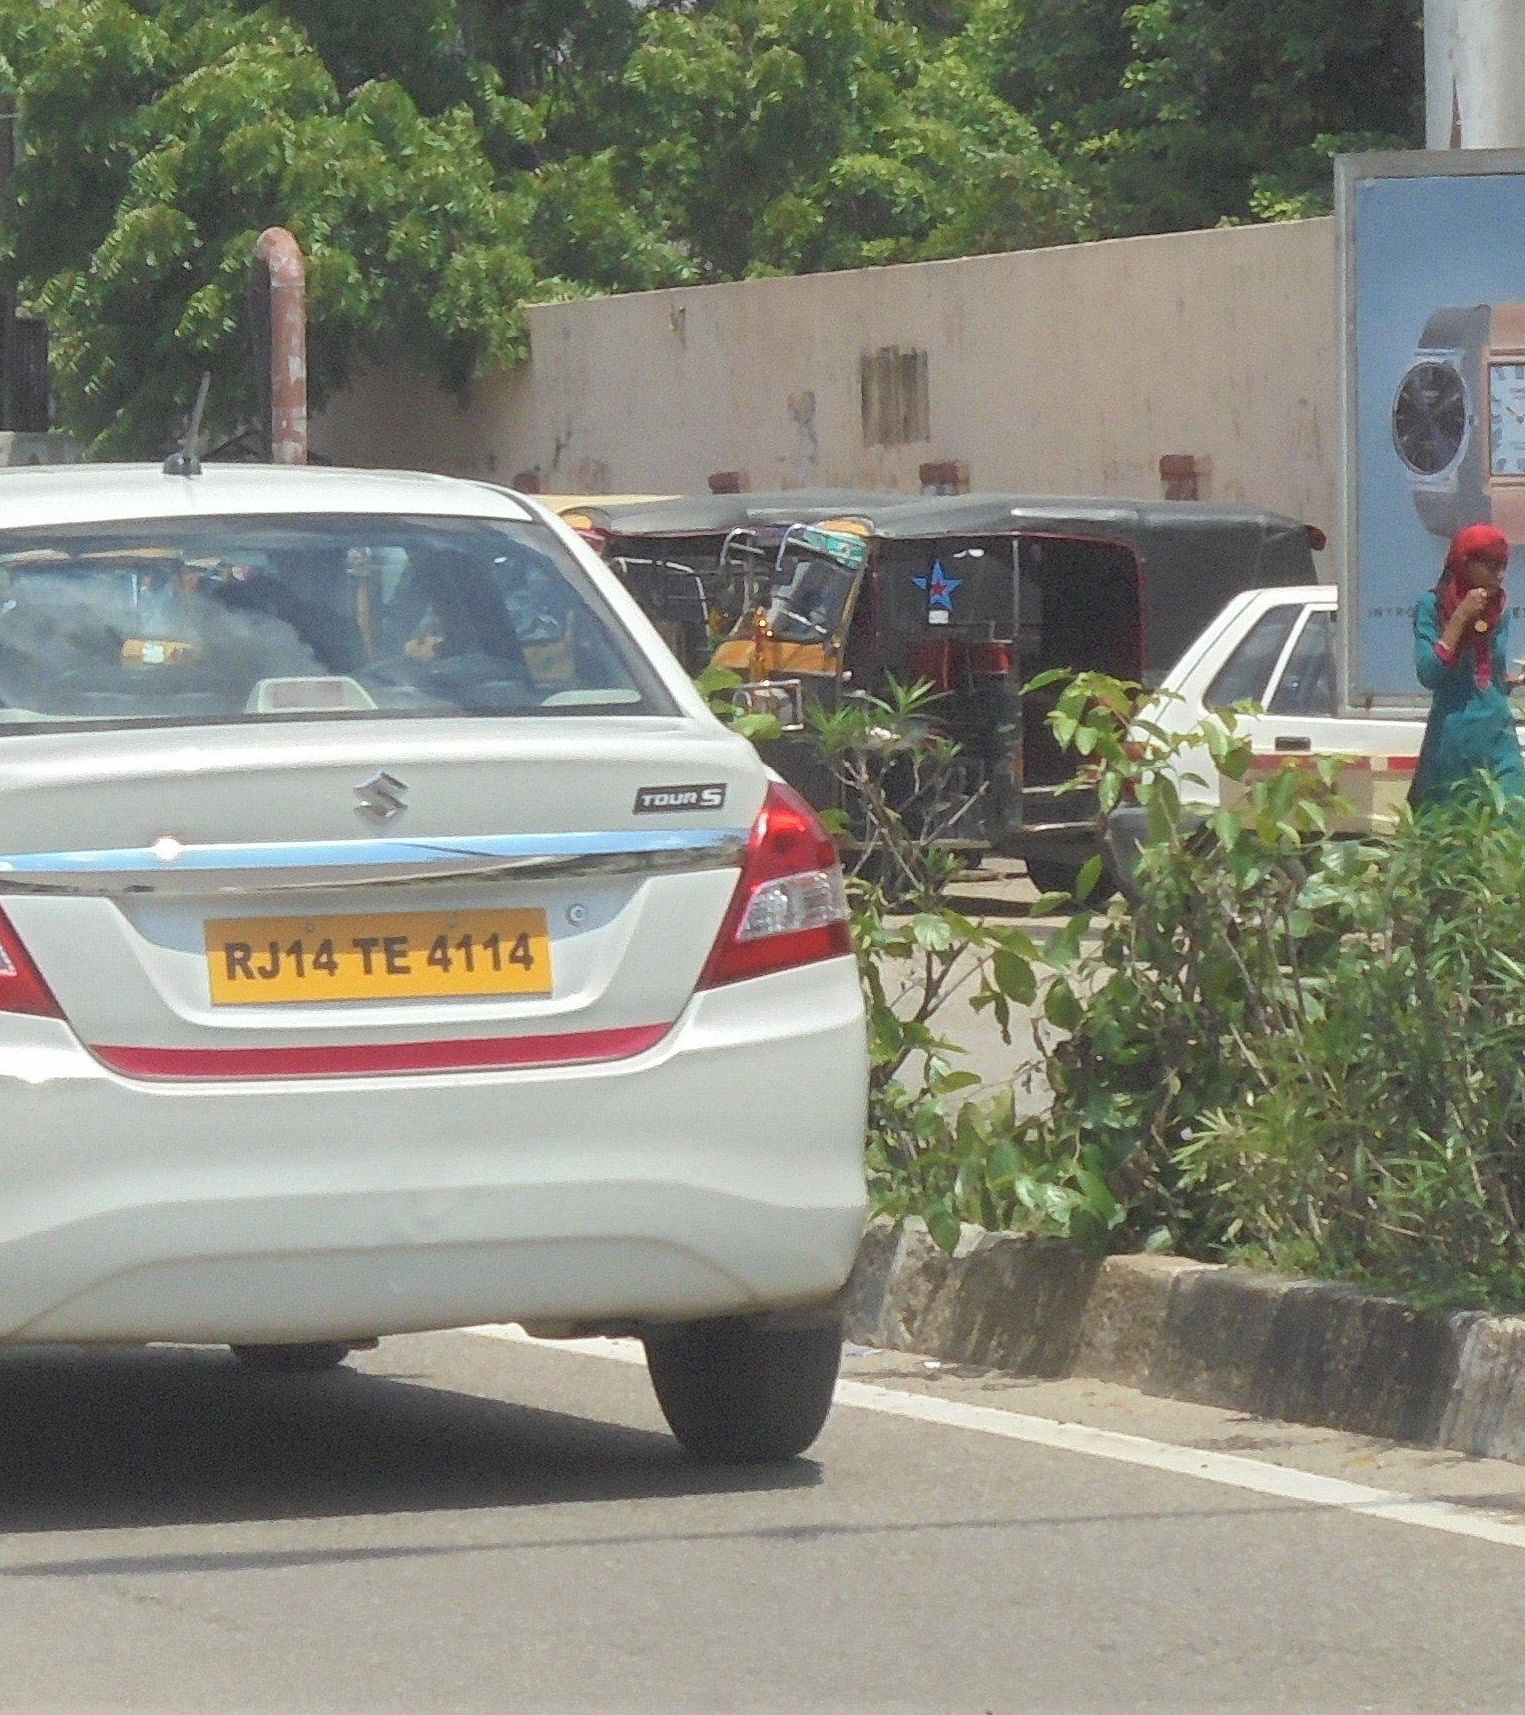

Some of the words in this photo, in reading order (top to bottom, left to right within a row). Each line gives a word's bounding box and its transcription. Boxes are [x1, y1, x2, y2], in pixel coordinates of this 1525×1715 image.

[640, 791, 698, 807] TOUR
[699, 787, 723, 807] S
[224, 938, 338, 981] RJ14
[353, 935, 412, 976] TE
[427, 932, 535, 973] 4114
